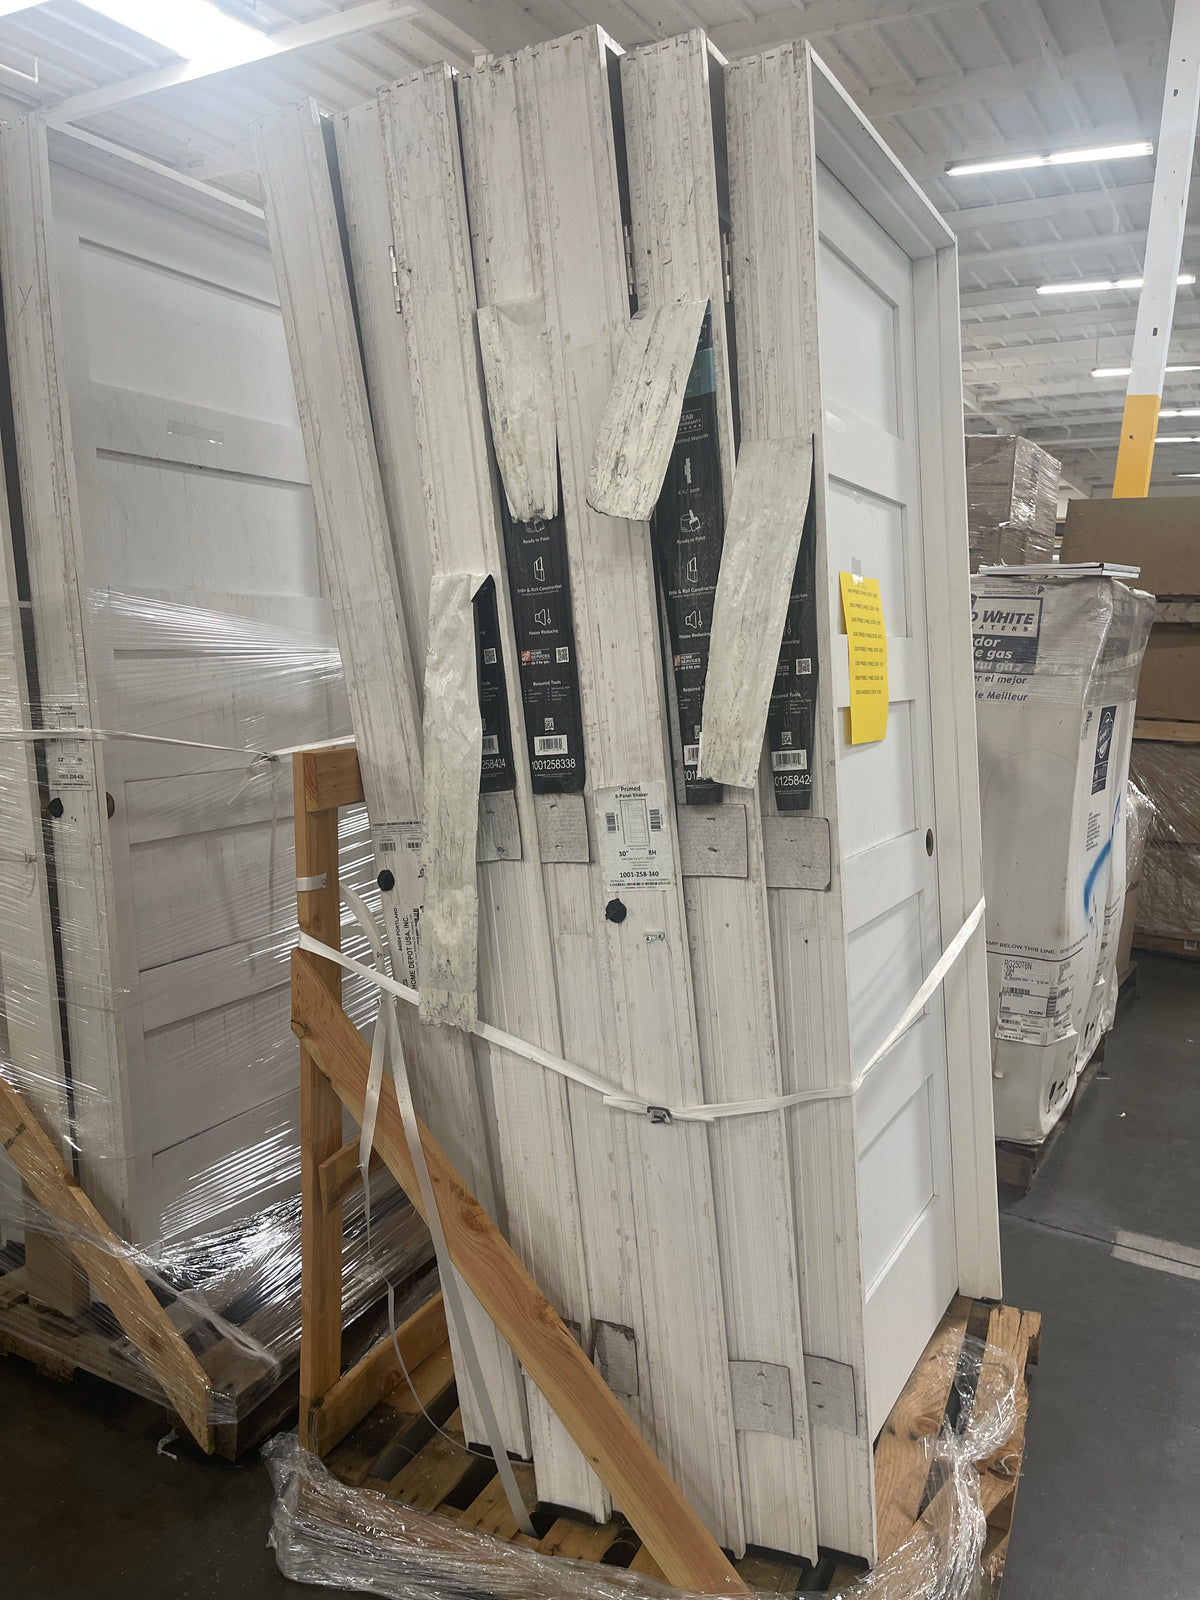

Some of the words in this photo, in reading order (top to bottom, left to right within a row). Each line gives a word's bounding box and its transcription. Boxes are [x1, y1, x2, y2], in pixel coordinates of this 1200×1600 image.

[681, 413, 694, 422] EAR
[982, 610, 1035, 625] WHITE
[972, 623, 1028, 632] ATERS
[986, 650, 1013, 660] gas
[984, 674, 994, 682] el
[997, 675, 1028, 686] mejor
[986, 691, 1028, 702] Meilleur
[532, 758, 576, 770] 1001258338
[406, 947, 414, 969] DEPOT
[409, 970, 417, 990] HOME
